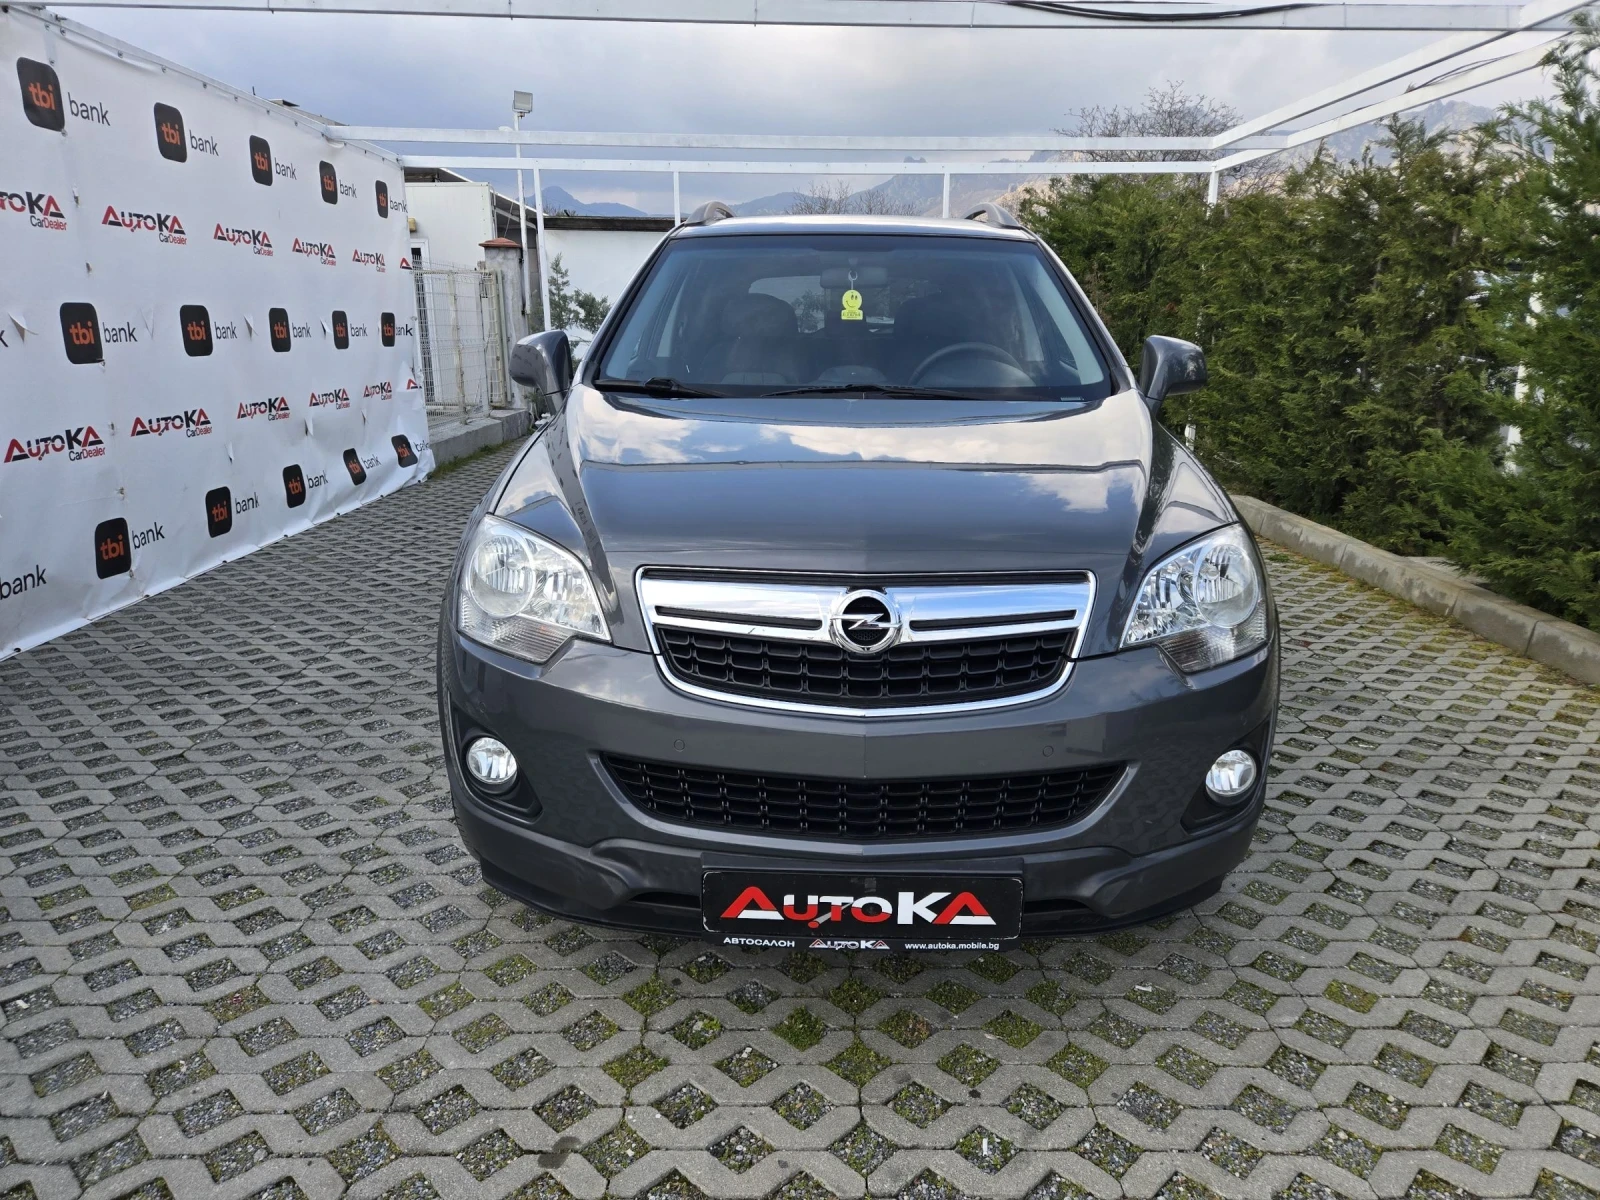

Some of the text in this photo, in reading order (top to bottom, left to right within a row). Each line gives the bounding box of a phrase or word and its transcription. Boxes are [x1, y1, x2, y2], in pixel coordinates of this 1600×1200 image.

[28, 82, 111, 127] tbi bank
[161, 122, 219, 156] tbi bank
[254, 151, 297, 180] tbi bank
[323, 174, 357, 198] tbi bank
[389, 196, 408, 213] bank
[30, 215, 67, 231] CarDealer
[101, 205, 186, 235] AUTOKA
[158, 232, 187, 245] CarDealer
[213, 223, 272, 248] AUTOKA
[69, 321, 138, 345] tbi bank
[187, 320, 238, 341] tbi bank
[274, 321, 312, 339] tbi bank
[335, 322, 368, 338] tbi bank
[237, 396, 290, 419] AUTOKA
[130, 408, 212, 437] AUTOKA
[186, 425, 213, 438] CarDealer
[4, 425, 104, 463] AUTOKA
[68, 446, 106, 462] CarDealer
[348, 453, 381, 474] tbi bank
[288, 476, 303, 496] tbi
[211, 500, 228, 523] tbi
[100, 521, 165, 561] tbi bank
[0, 564, 47, 601] bank
[720, 886, 997, 928] AUTOKA
[723, 937, 795, 948] АВТОСАЛОН
[904, 941, 1000, 951] www.autoka.mobile.bg
